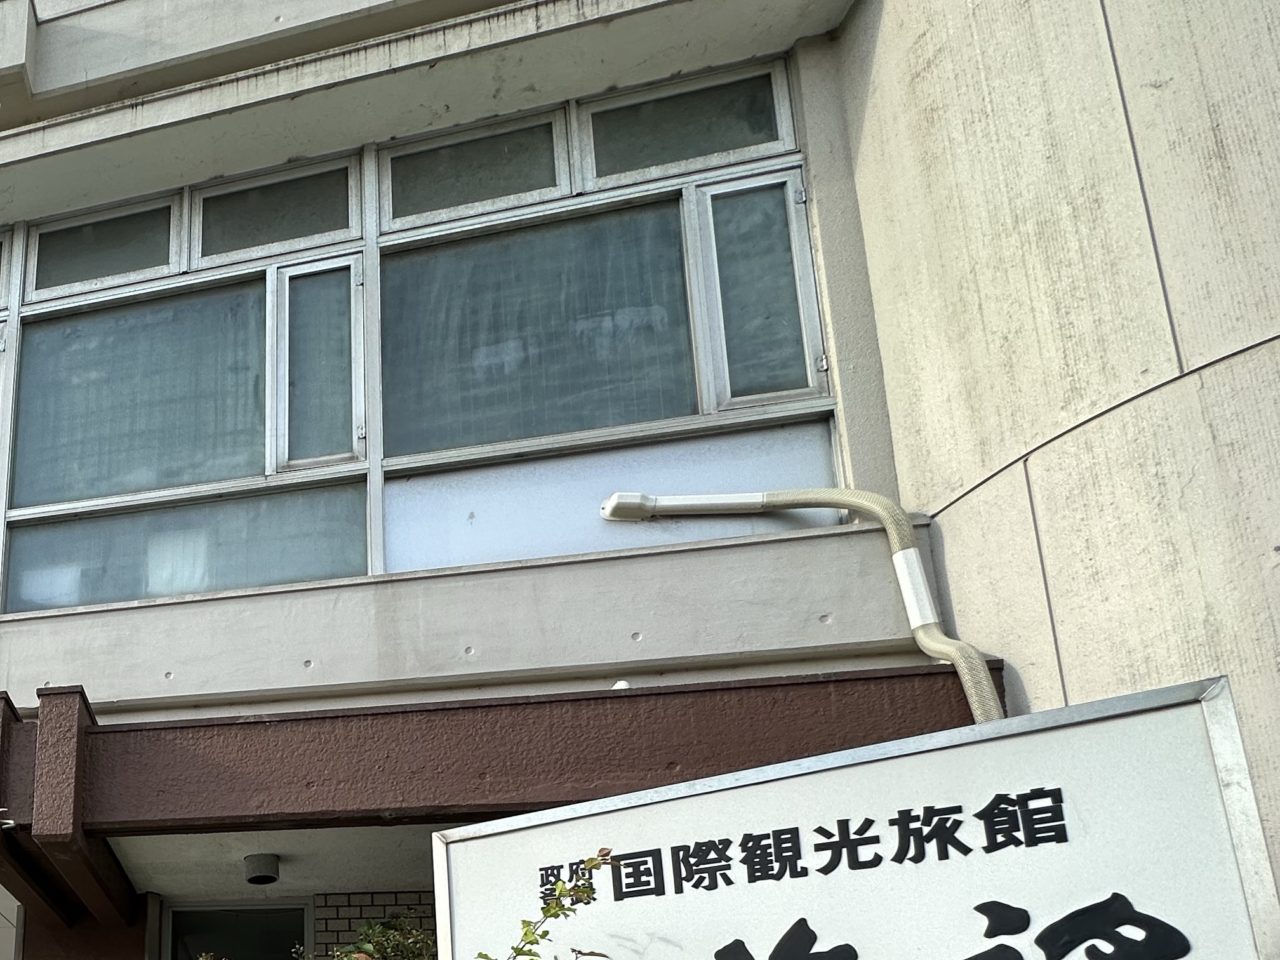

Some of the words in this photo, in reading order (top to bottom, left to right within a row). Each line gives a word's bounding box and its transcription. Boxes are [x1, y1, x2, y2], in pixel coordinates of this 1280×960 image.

[609, 786, 1070, 902] 国際観光旅館
